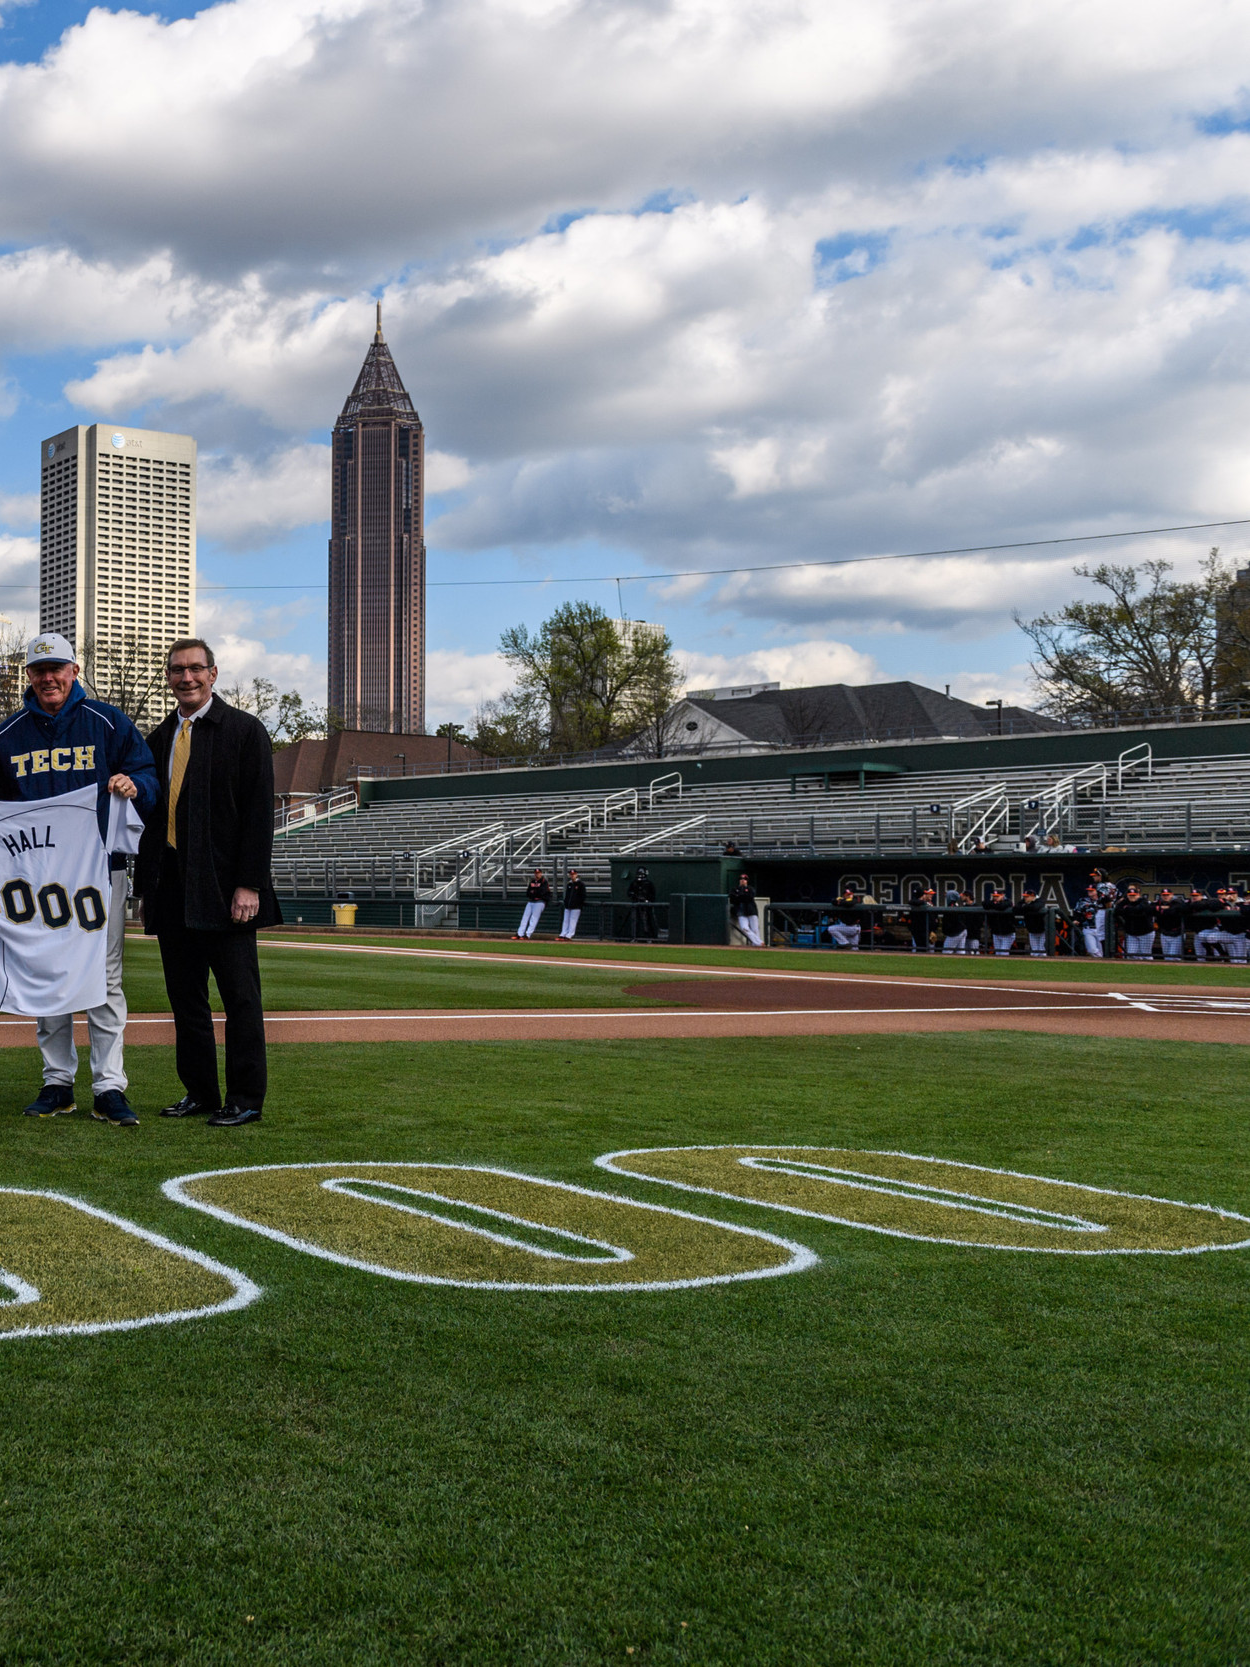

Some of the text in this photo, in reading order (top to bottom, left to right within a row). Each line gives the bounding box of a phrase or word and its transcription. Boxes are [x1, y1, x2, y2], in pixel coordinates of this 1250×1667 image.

[11, 745, 96, 778] TECH
[2, 825, 56, 857] HALL
[837, 873, 1074, 916] GEORGIA
